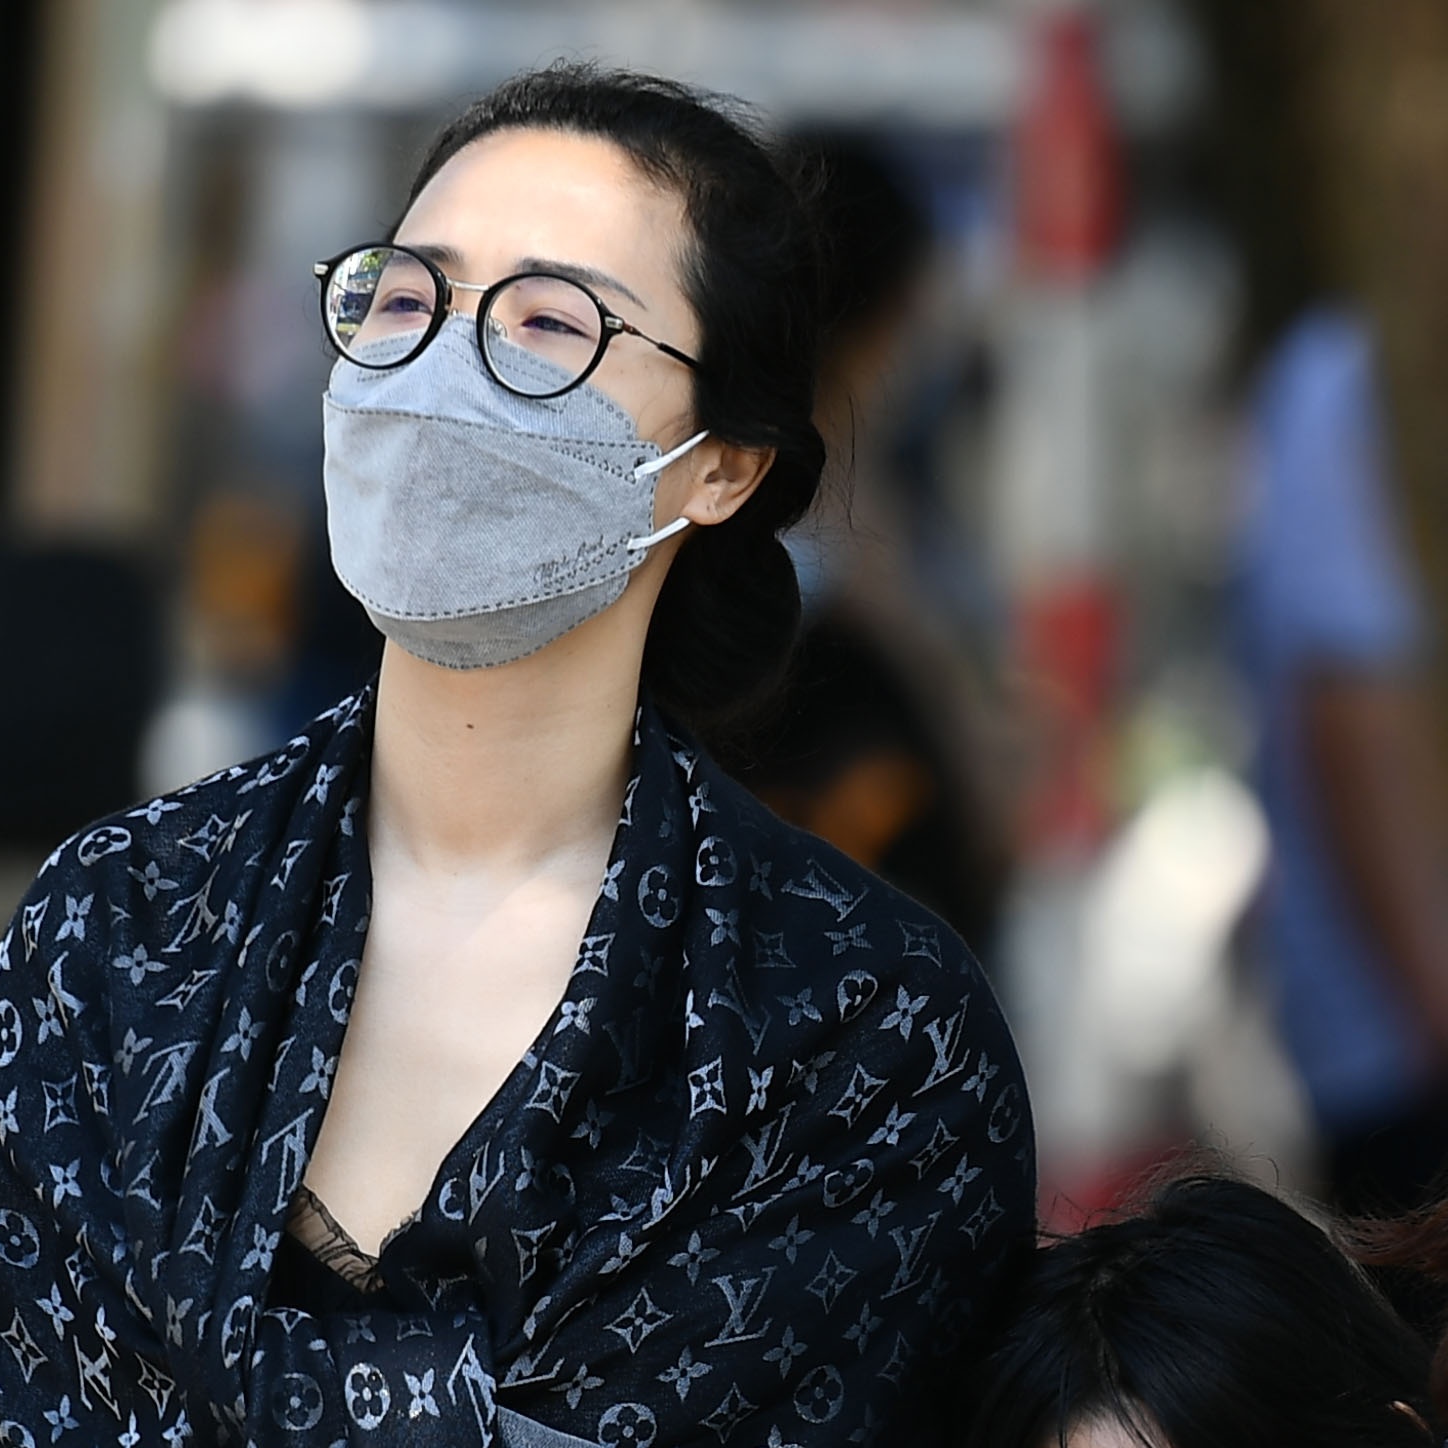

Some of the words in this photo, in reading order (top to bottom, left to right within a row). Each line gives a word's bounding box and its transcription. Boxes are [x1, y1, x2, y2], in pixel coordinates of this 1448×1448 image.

[911, 993, 971, 1098] LV
[881, 1210, 943, 1300] LV
[704, 1266, 777, 1349] LV
